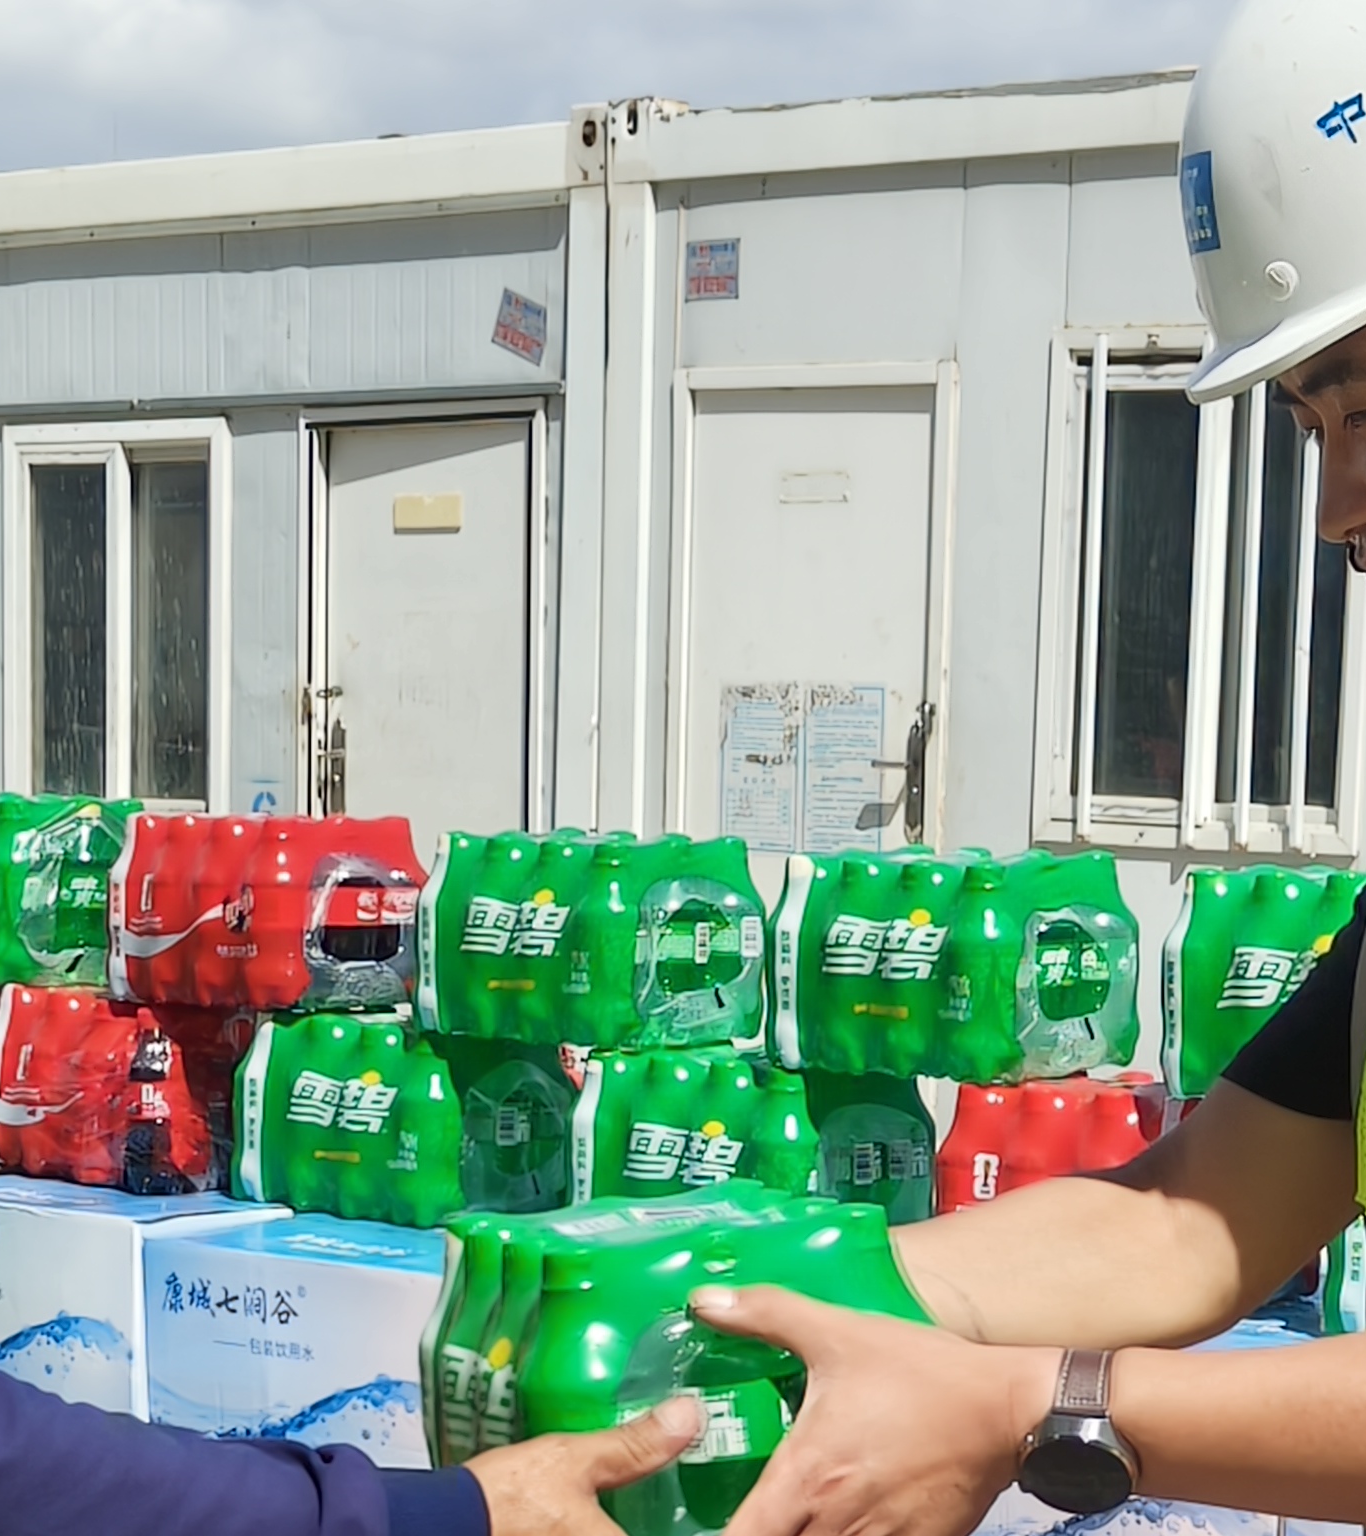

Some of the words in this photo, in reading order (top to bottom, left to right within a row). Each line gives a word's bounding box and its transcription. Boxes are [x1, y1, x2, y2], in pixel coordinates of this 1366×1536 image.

[459, 896, 571, 957] 雪碧
[821, 913, 949, 980] 雪碧
[286, 1070, 399, 1133] 雪碧
[622, 1122, 744, 1185] 雪碧
